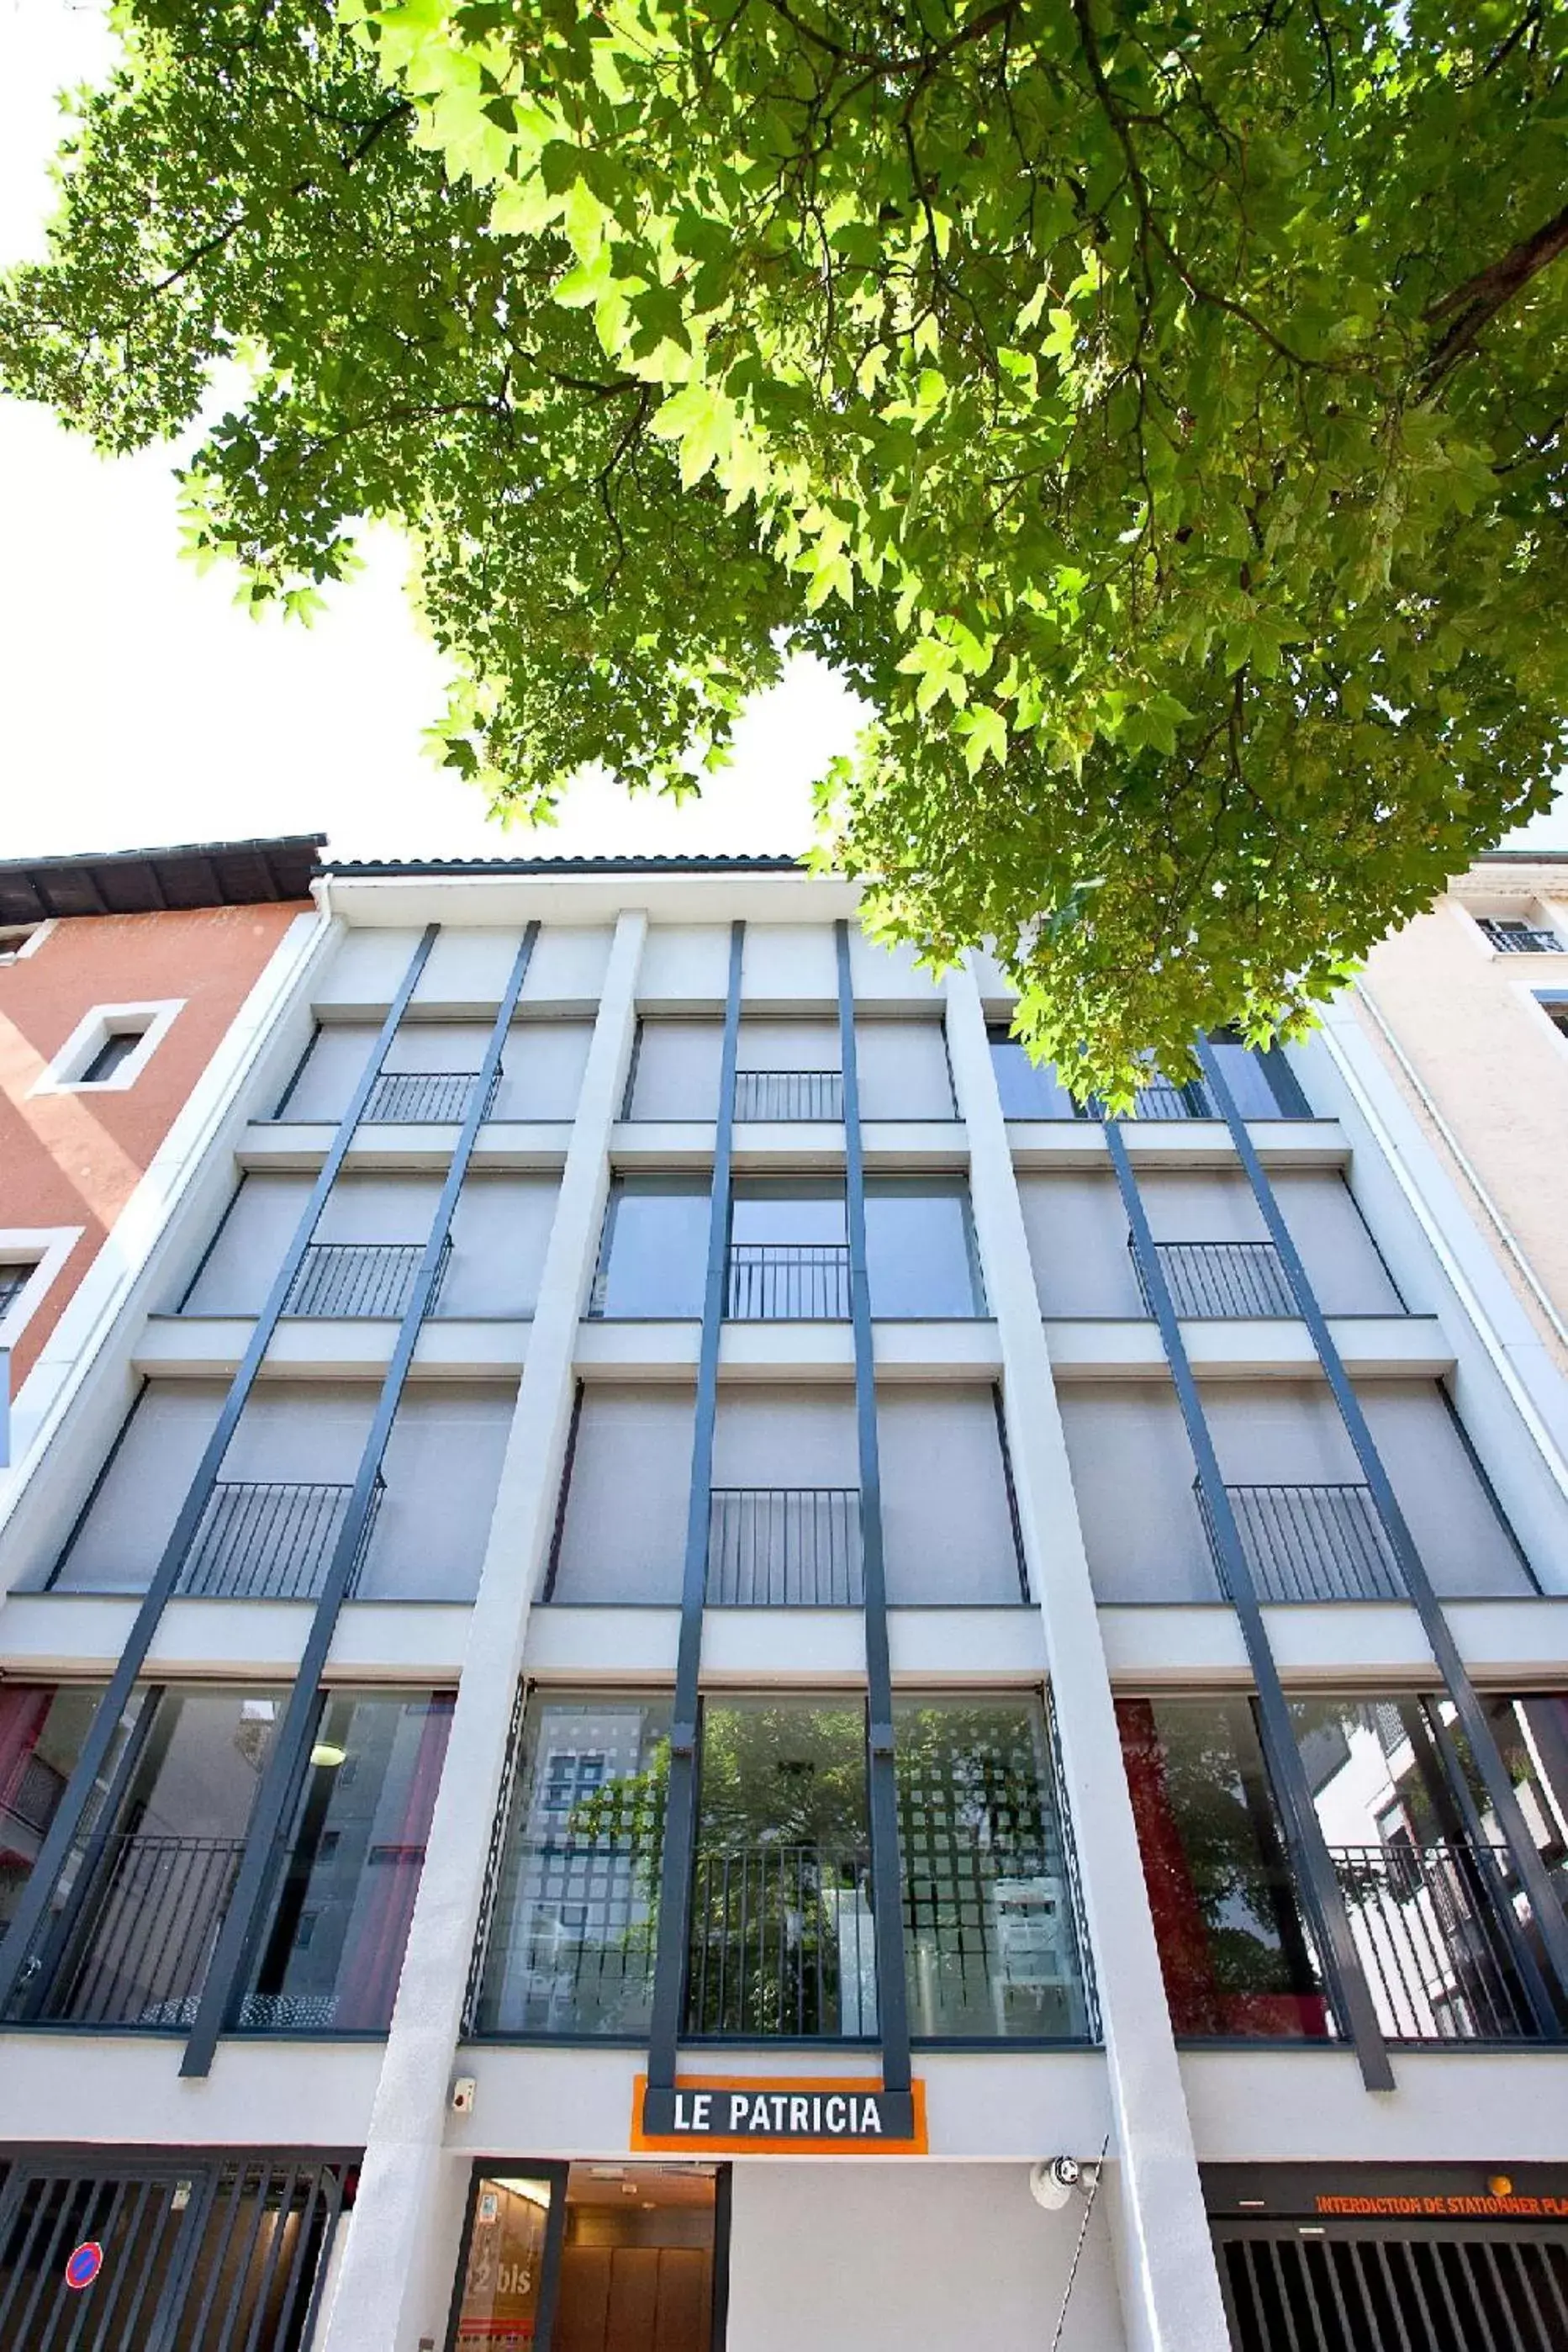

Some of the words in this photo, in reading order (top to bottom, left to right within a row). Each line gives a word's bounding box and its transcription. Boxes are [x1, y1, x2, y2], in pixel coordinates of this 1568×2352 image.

[674, 2094, 712, 2130] LE
[729, 2094, 882, 2133] PATRICIA
[1316, 2196, 1422, 2214] INTERDICTION
[1423, 2196, 1446, 2214] DE
[1447, 2196, 1542, 2215] STATIONNER
[497, 2262, 531, 2295] bis
